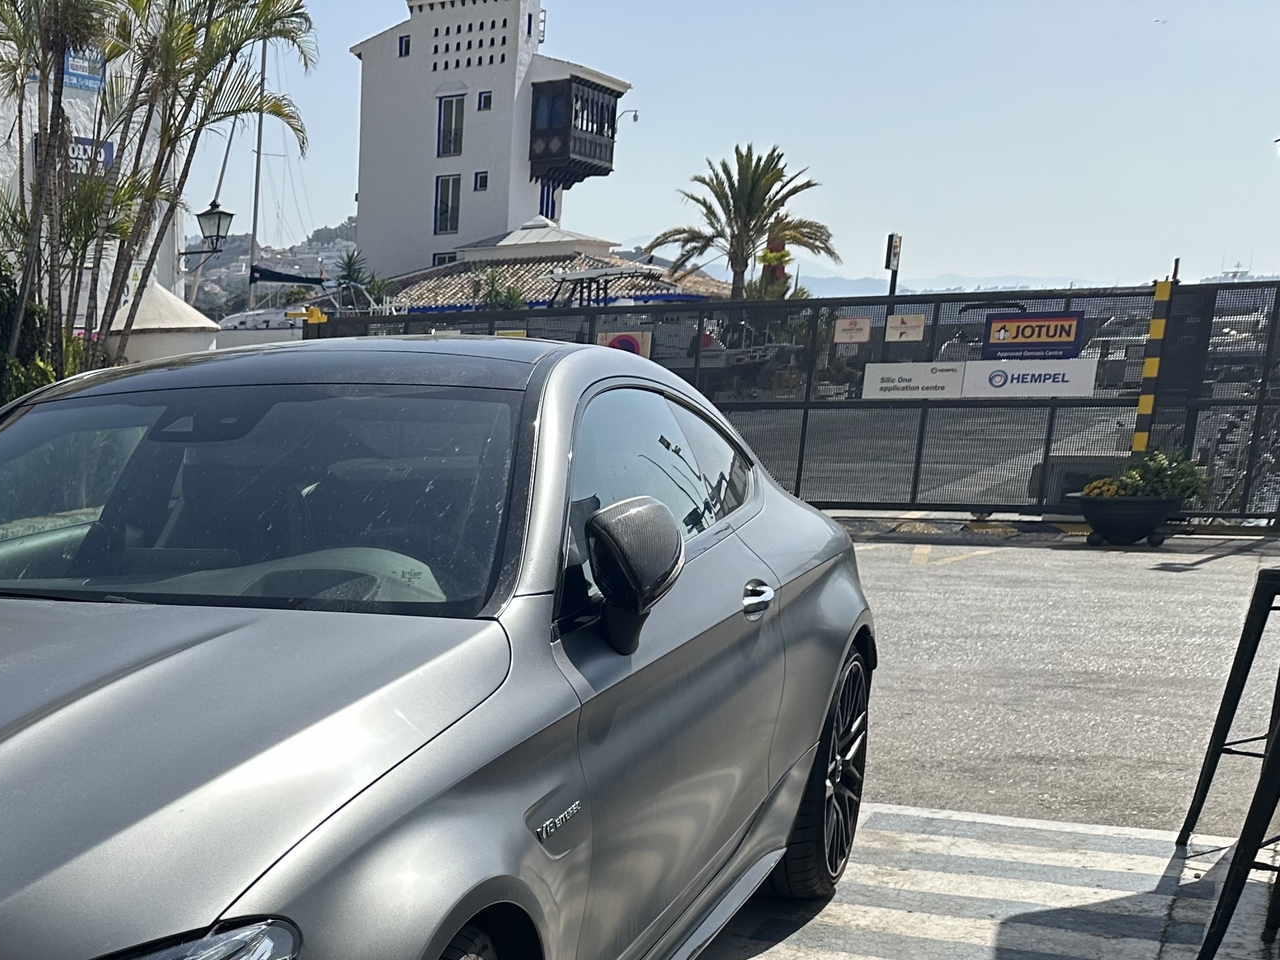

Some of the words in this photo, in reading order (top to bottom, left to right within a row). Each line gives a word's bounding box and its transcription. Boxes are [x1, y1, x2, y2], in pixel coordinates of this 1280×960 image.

[1011, 323, 1073, 340] JOTUN
[996, 350, 1023, 358] Approved
[897, 376, 913, 384] One
[1010, 372, 1070, 384] HEMPEL
[878, 384, 920, 393] application
[920, 383, 946, 392] centre
